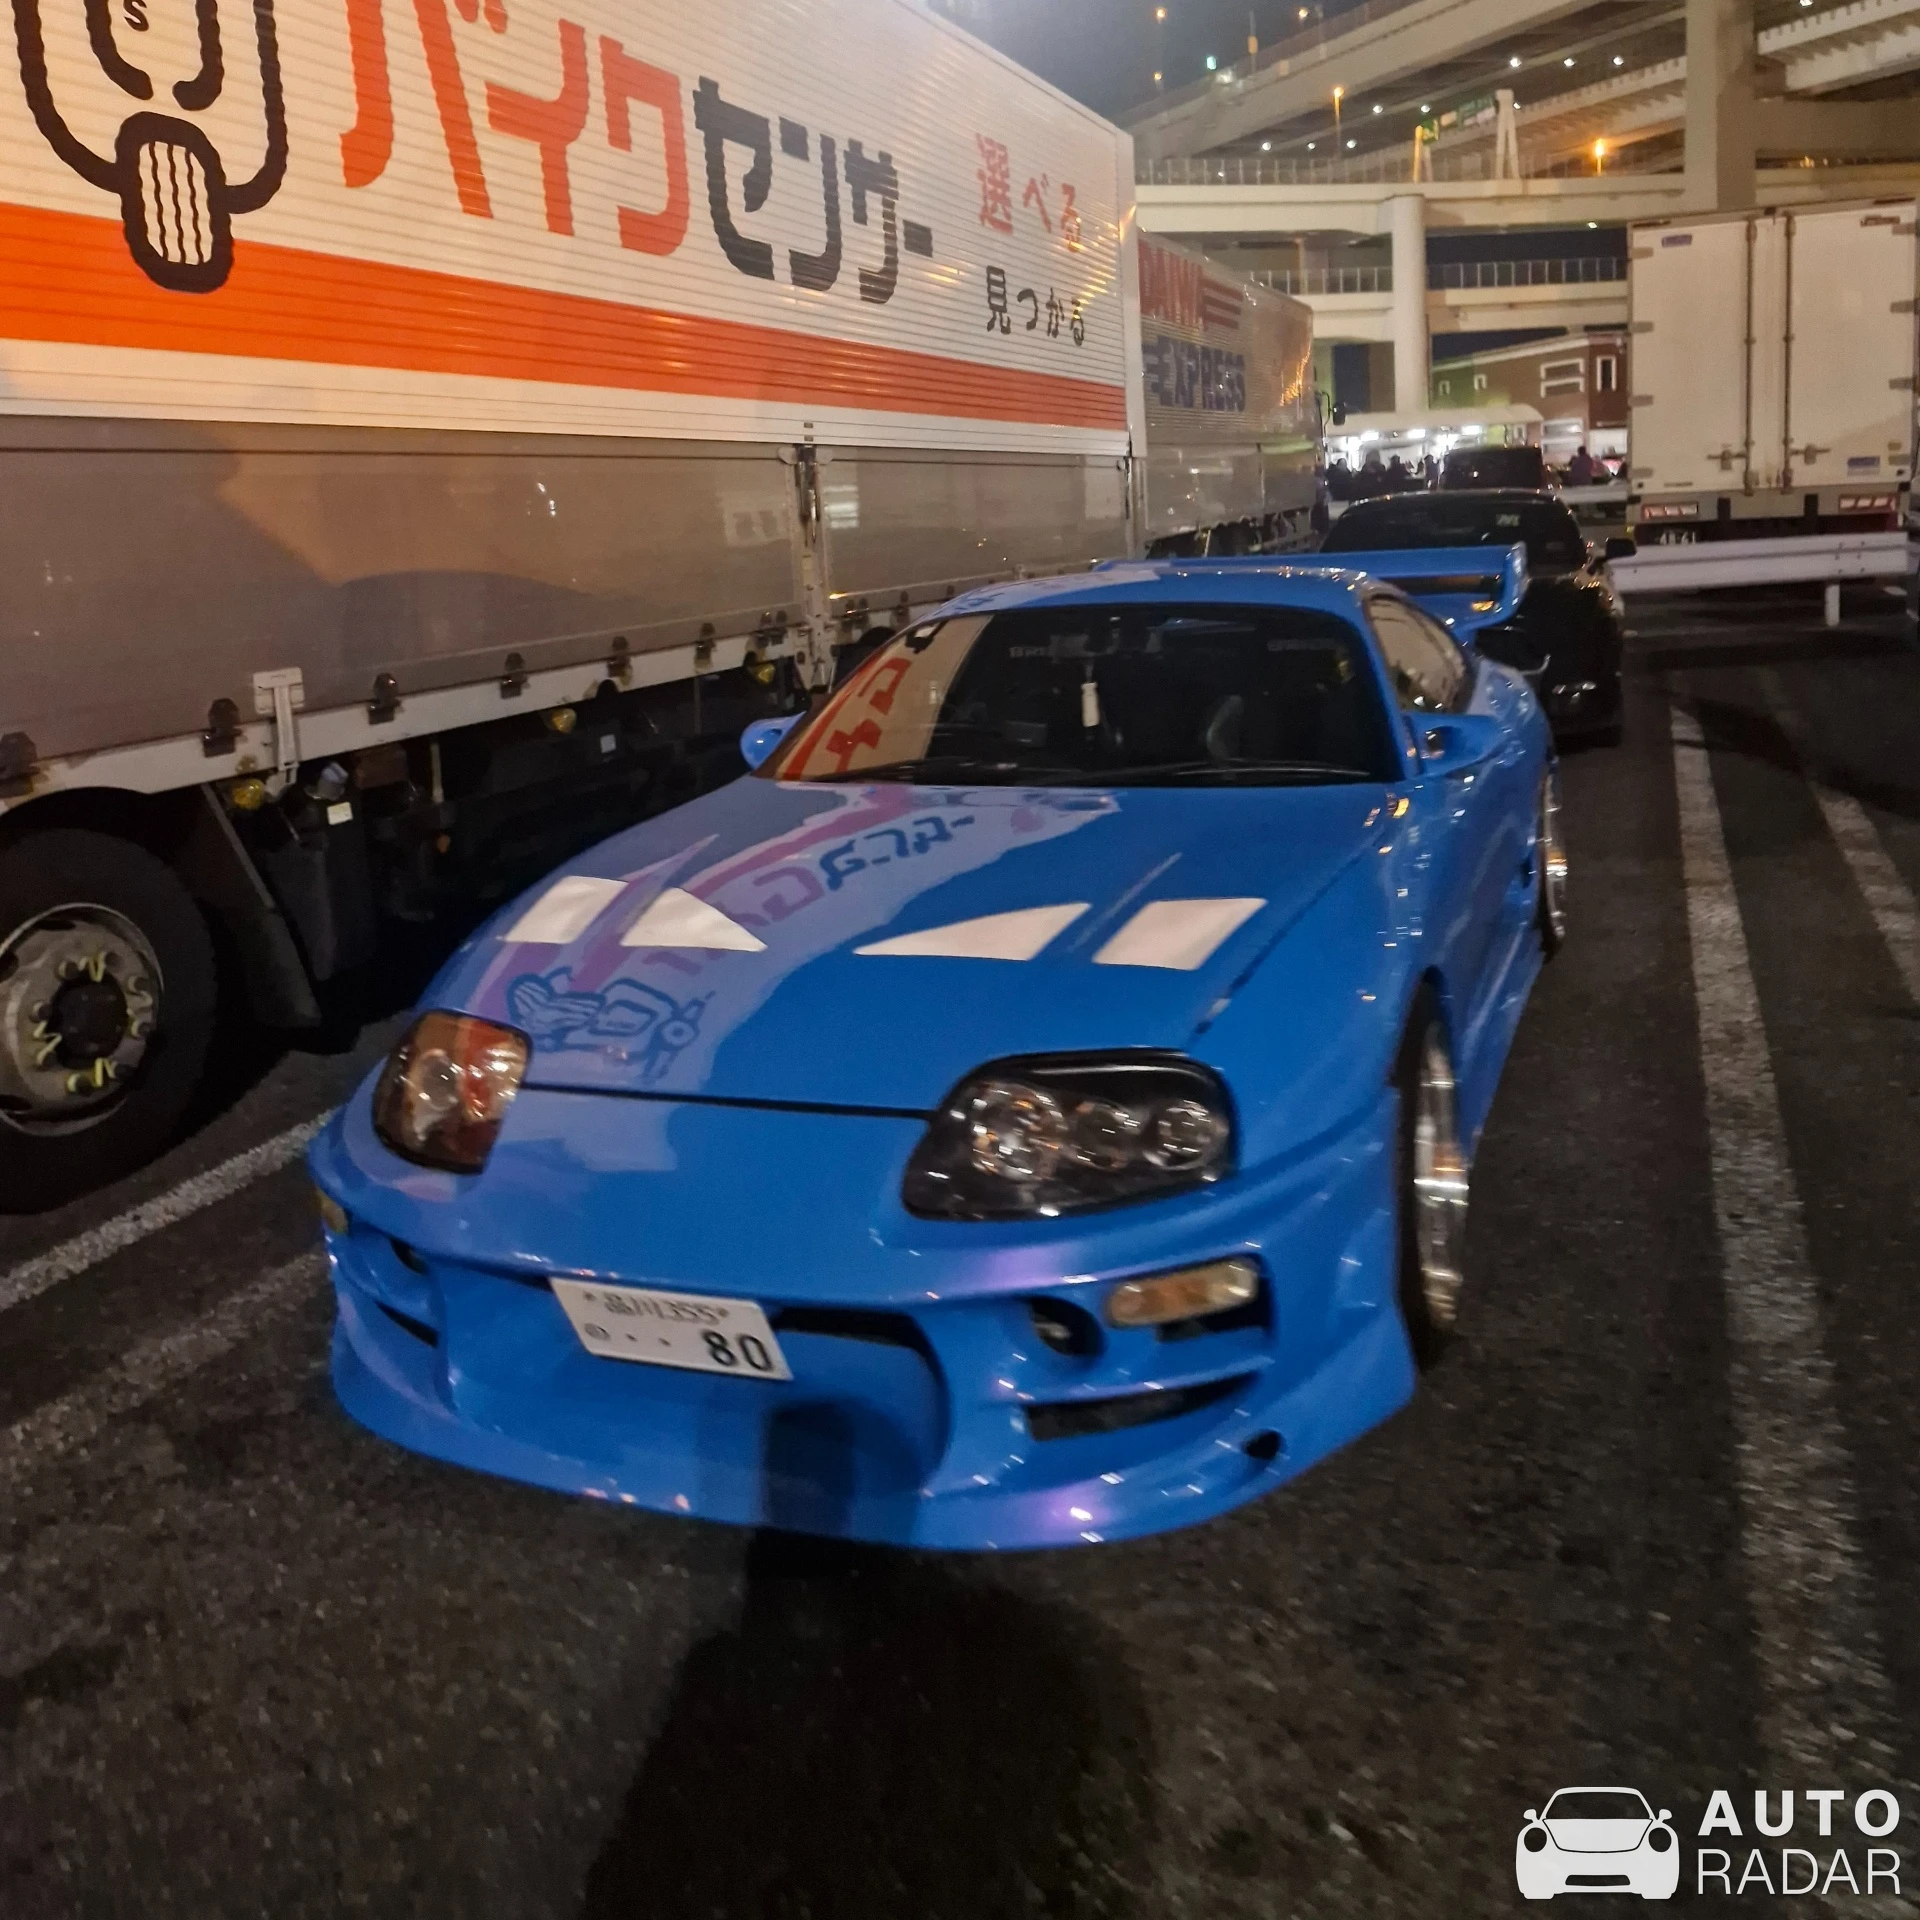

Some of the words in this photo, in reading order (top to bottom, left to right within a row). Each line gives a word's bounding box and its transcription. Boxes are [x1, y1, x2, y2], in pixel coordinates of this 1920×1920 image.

[976, 132, 1082, 252] 選べる
[986, 265, 1085, 347] 見つかる
[702, 1329, 773, 1371] 80
